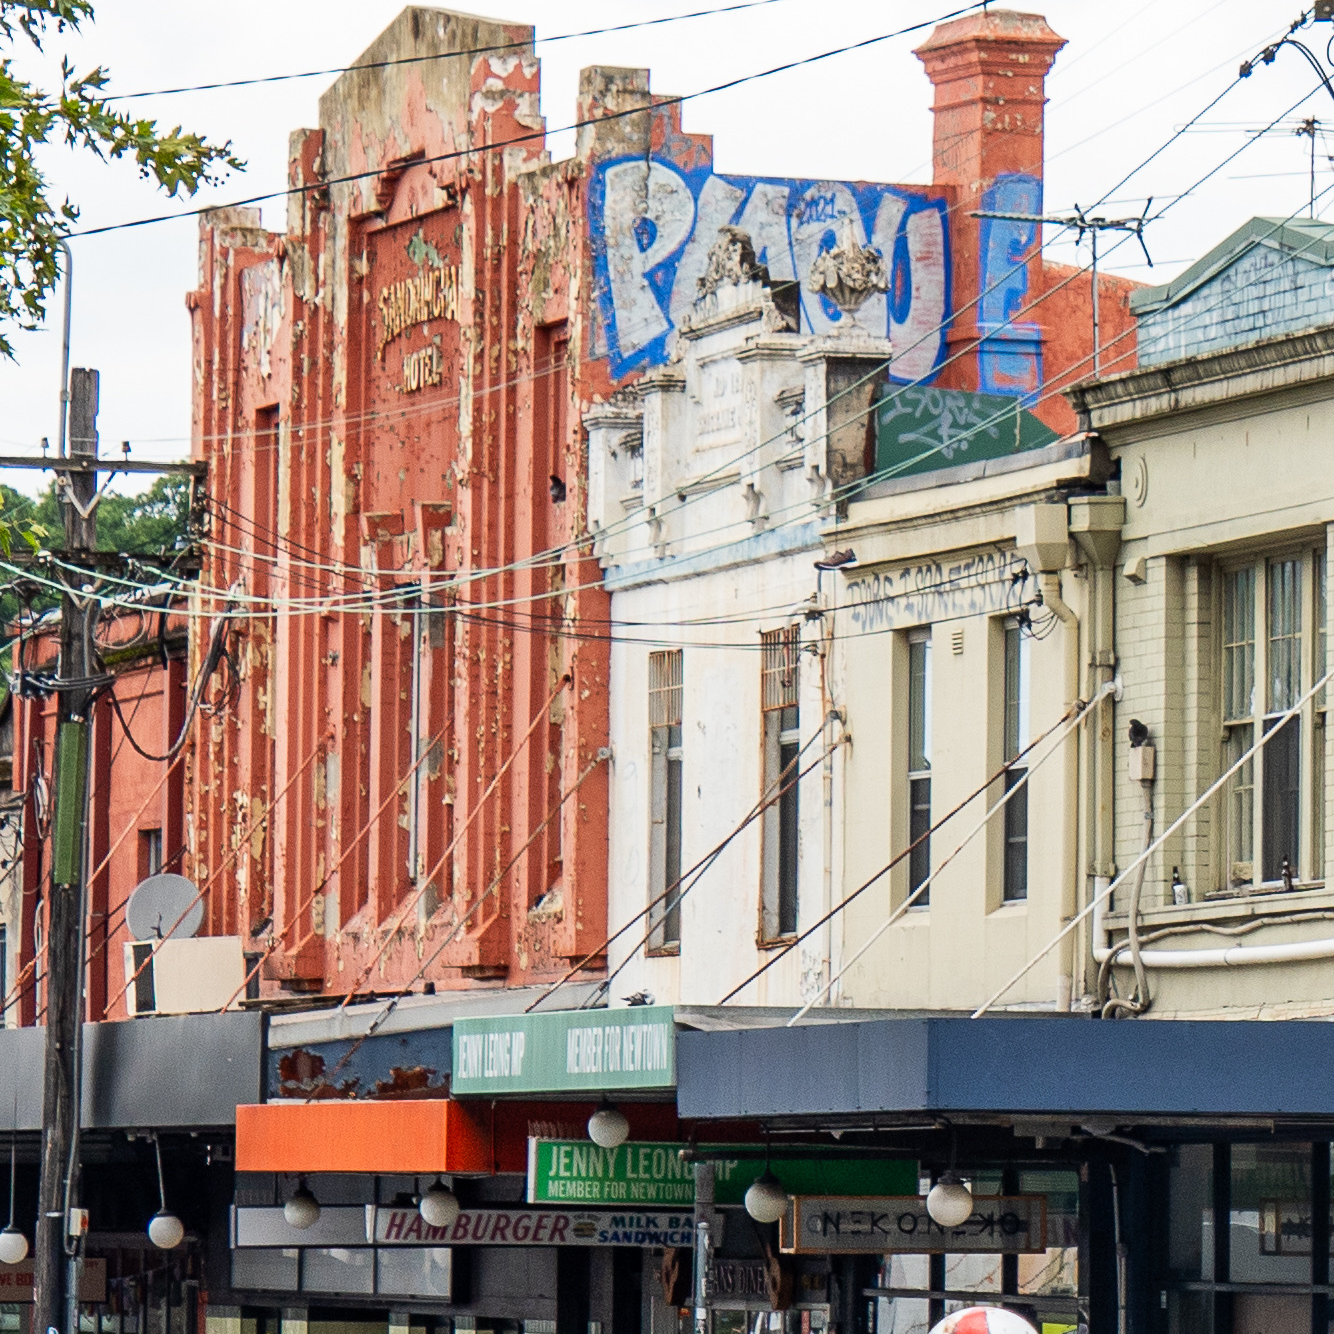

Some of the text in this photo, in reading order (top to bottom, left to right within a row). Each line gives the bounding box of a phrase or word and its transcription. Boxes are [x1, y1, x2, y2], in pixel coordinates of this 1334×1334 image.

[458, 1031, 525, 1079] JENNY LEONG MP
[566, 1023, 668, 1074] MEMBER FOR NEWTOWN
[548, 1145, 619, 1179] JENNY
[548, 1180, 694, 1201] MEMBER FOR NEWTOWN
[384, 1210, 570, 1243] HAMBURGER
[610, 1216, 659, 1229] MILK
[668, 1216, 694, 1230] BA
